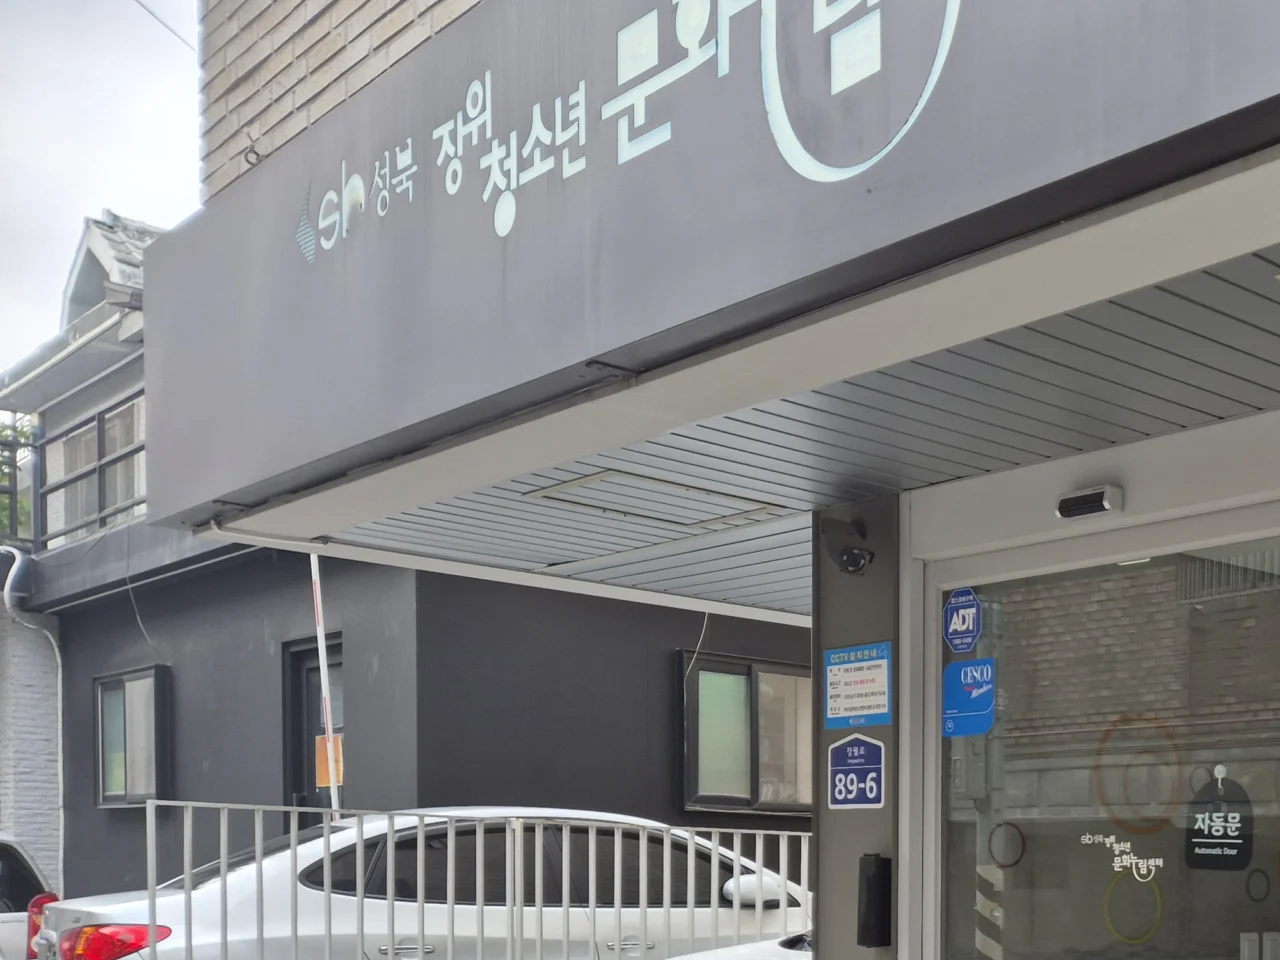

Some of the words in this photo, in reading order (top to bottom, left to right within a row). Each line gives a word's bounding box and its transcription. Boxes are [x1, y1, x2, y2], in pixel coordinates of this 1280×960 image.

[368, 137, 418, 217] 성북
[432, 69, 492, 196] 장위
[480, 79, 587, 238] 청소년
[948, 607, 977, 633] ADT
[830, 653, 849, 664] CCTV
[961, 664, 992, 684] CESCO
[846, 746, 865, 757] 장월로
[834, 772, 877, 800] 89-6
[1193, 811, 1242, 837] 자동문
[1080, 832, 1094, 844] sb
[1111, 841, 1131, 855] 청소년
[1194, 846, 1223, 855] Automatic
[1223, 847, 1238, 855] Door
[1111, 852, 1164, 882] 문화누림센터
